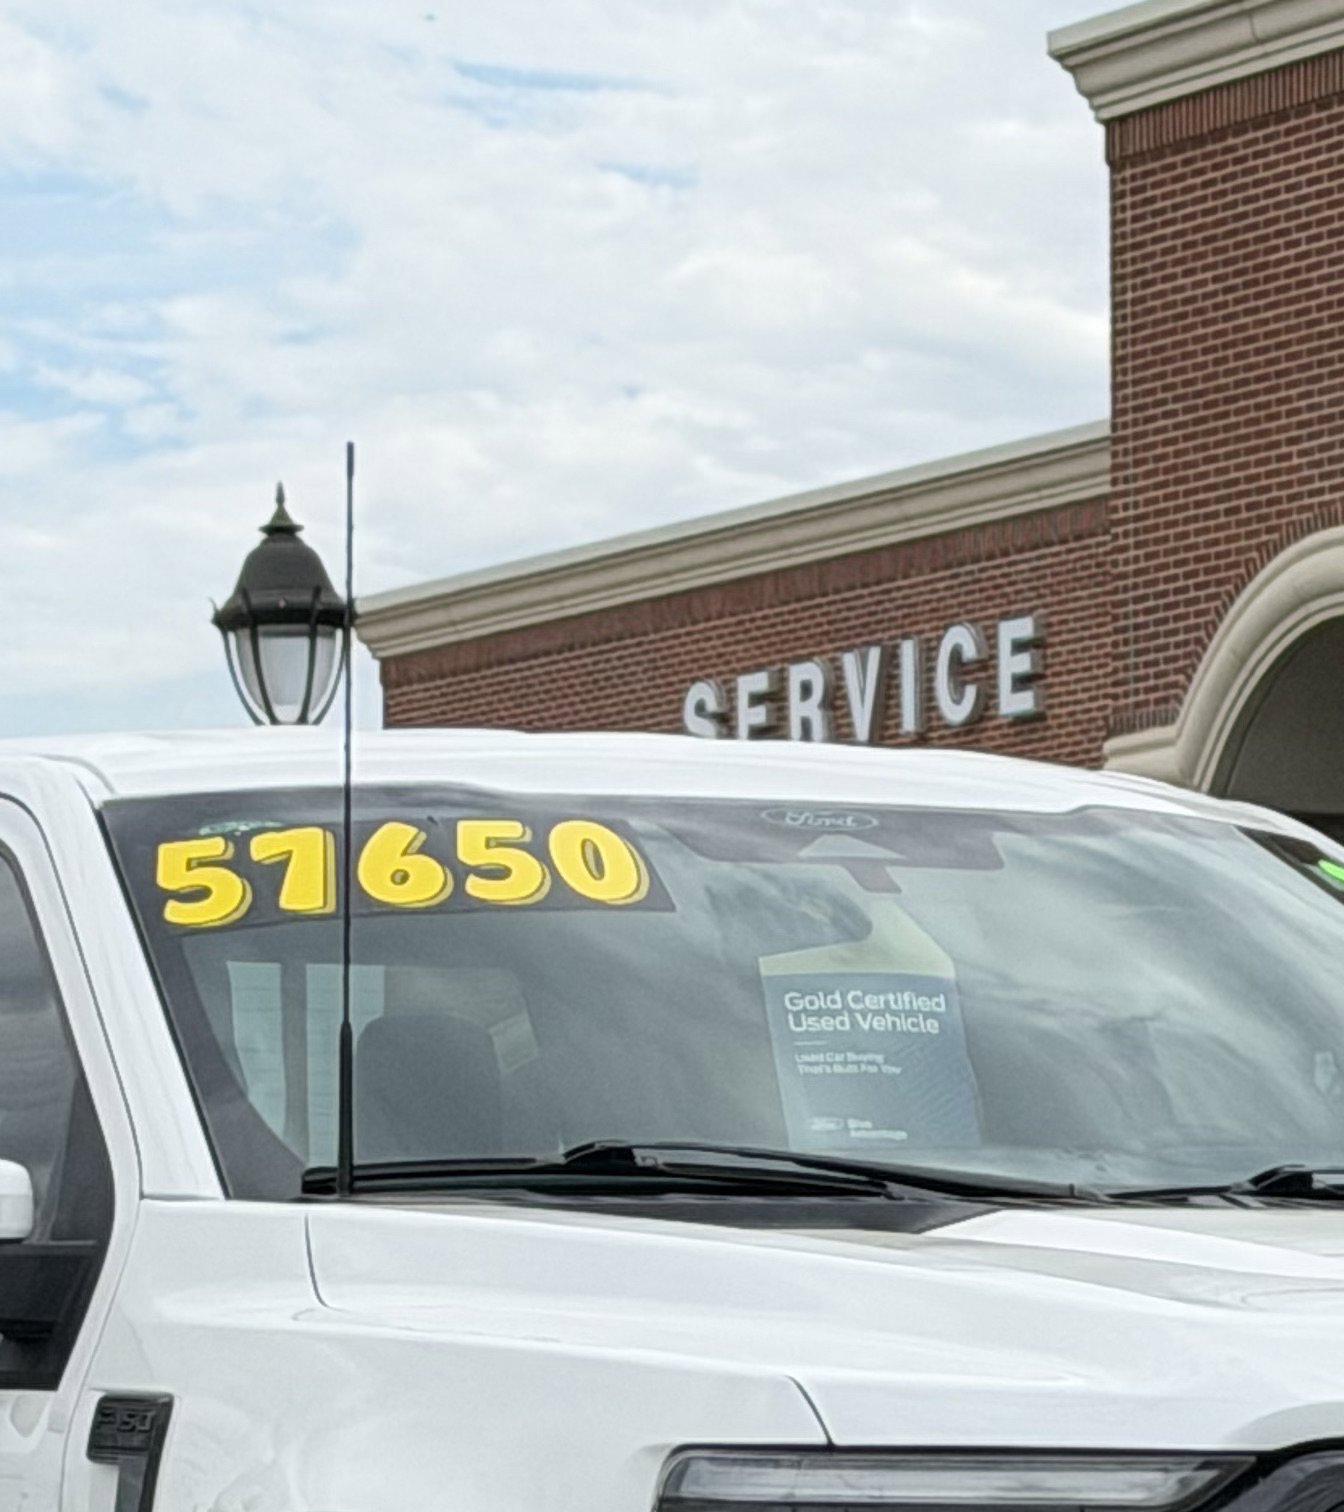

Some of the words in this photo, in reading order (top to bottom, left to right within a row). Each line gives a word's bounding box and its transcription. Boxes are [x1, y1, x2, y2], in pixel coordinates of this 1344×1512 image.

[684, 614, 1046, 742] SERVICE
[156, 819, 651, 928] 57650
[784, 989, 843, 1011] Gold
[847, 990, 946, 1013] Certified
[788, 1010, 851, 1032] Used
[855, 1011, 940, 1034] Vehicle
